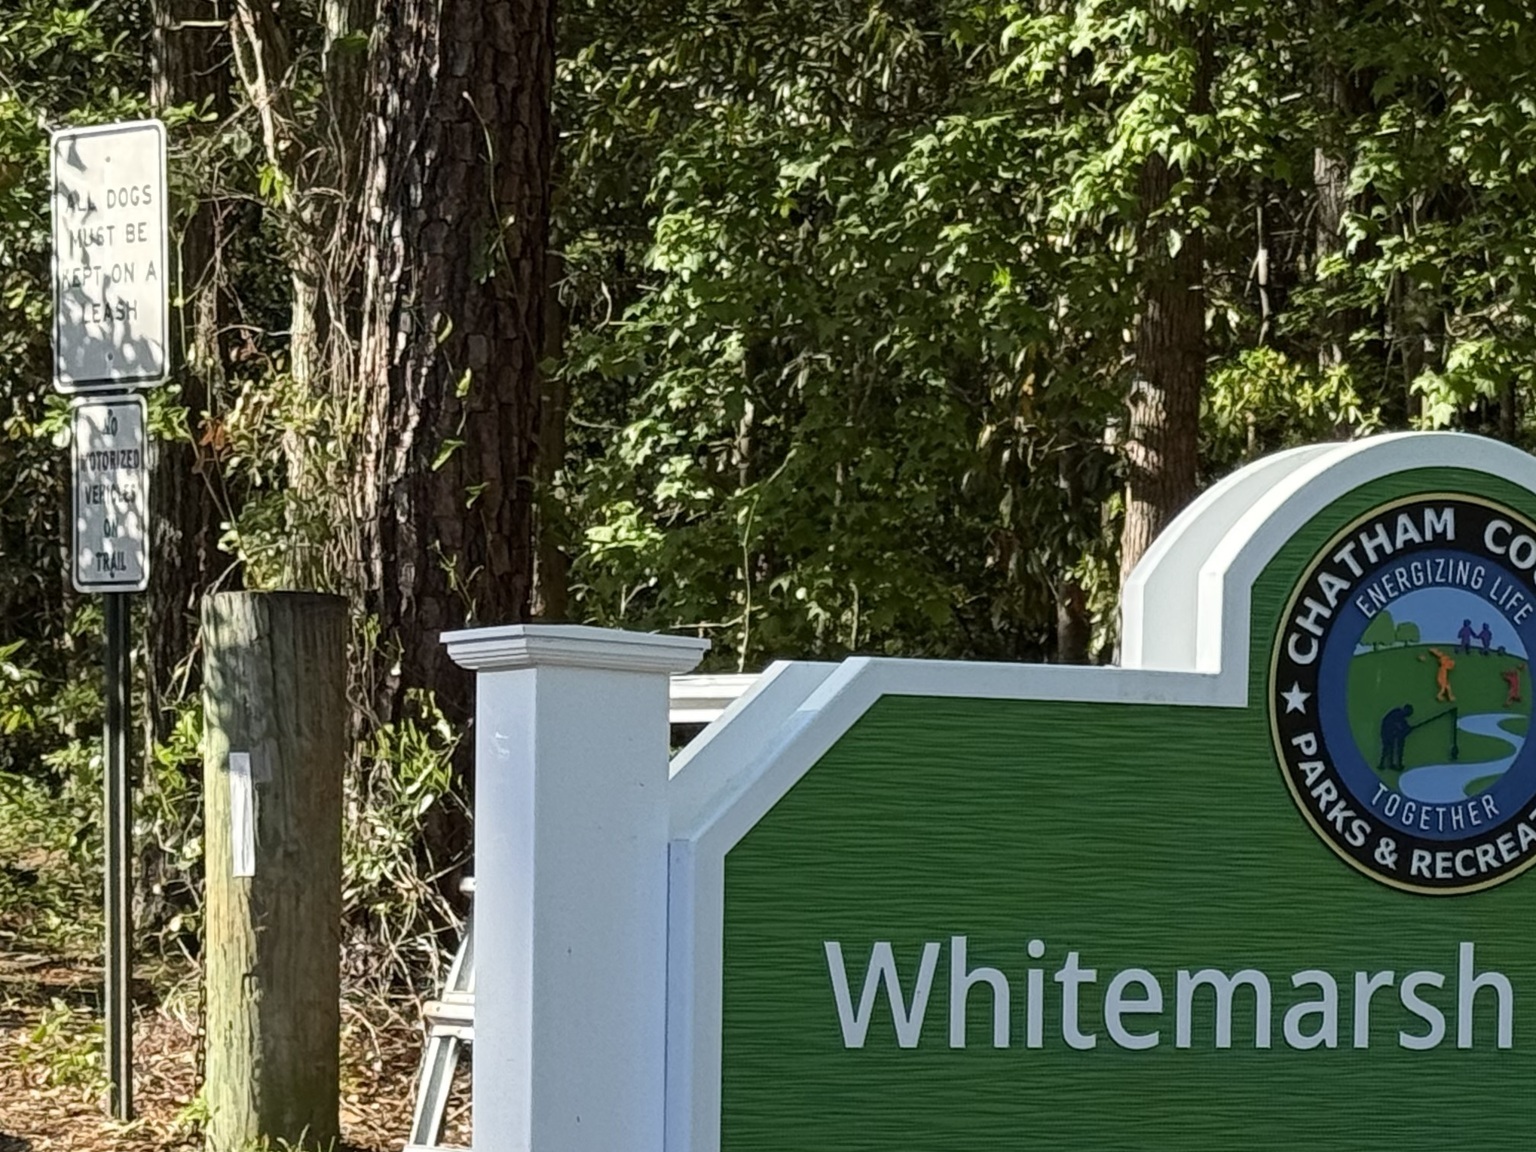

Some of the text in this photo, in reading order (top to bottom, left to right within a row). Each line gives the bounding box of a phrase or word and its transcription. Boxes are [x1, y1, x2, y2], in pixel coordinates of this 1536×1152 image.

[107, 184, 152, 209] DOGS
[70, 222, 147, 250] MUST BE
[62, 260, 157, 289] KEPT ON A
[82, 299, 138, 324] LEASH
[103, 416, 118, 437] NO
[103, 518, 119, 539] ON
[95, 551, 127, 573] TRAIL
[1286, 507, 1457, 667] CHATHAM
[1355, 557, 1534, 627] ENERGIZING LIFE
[1290, 731, 1373, 849] PARKS
[1374, 836, 1399, 870] &
[1370, 782, 1500, 833] TOGETHER
[822, 936, 1513, 1052] Whitemarsh
